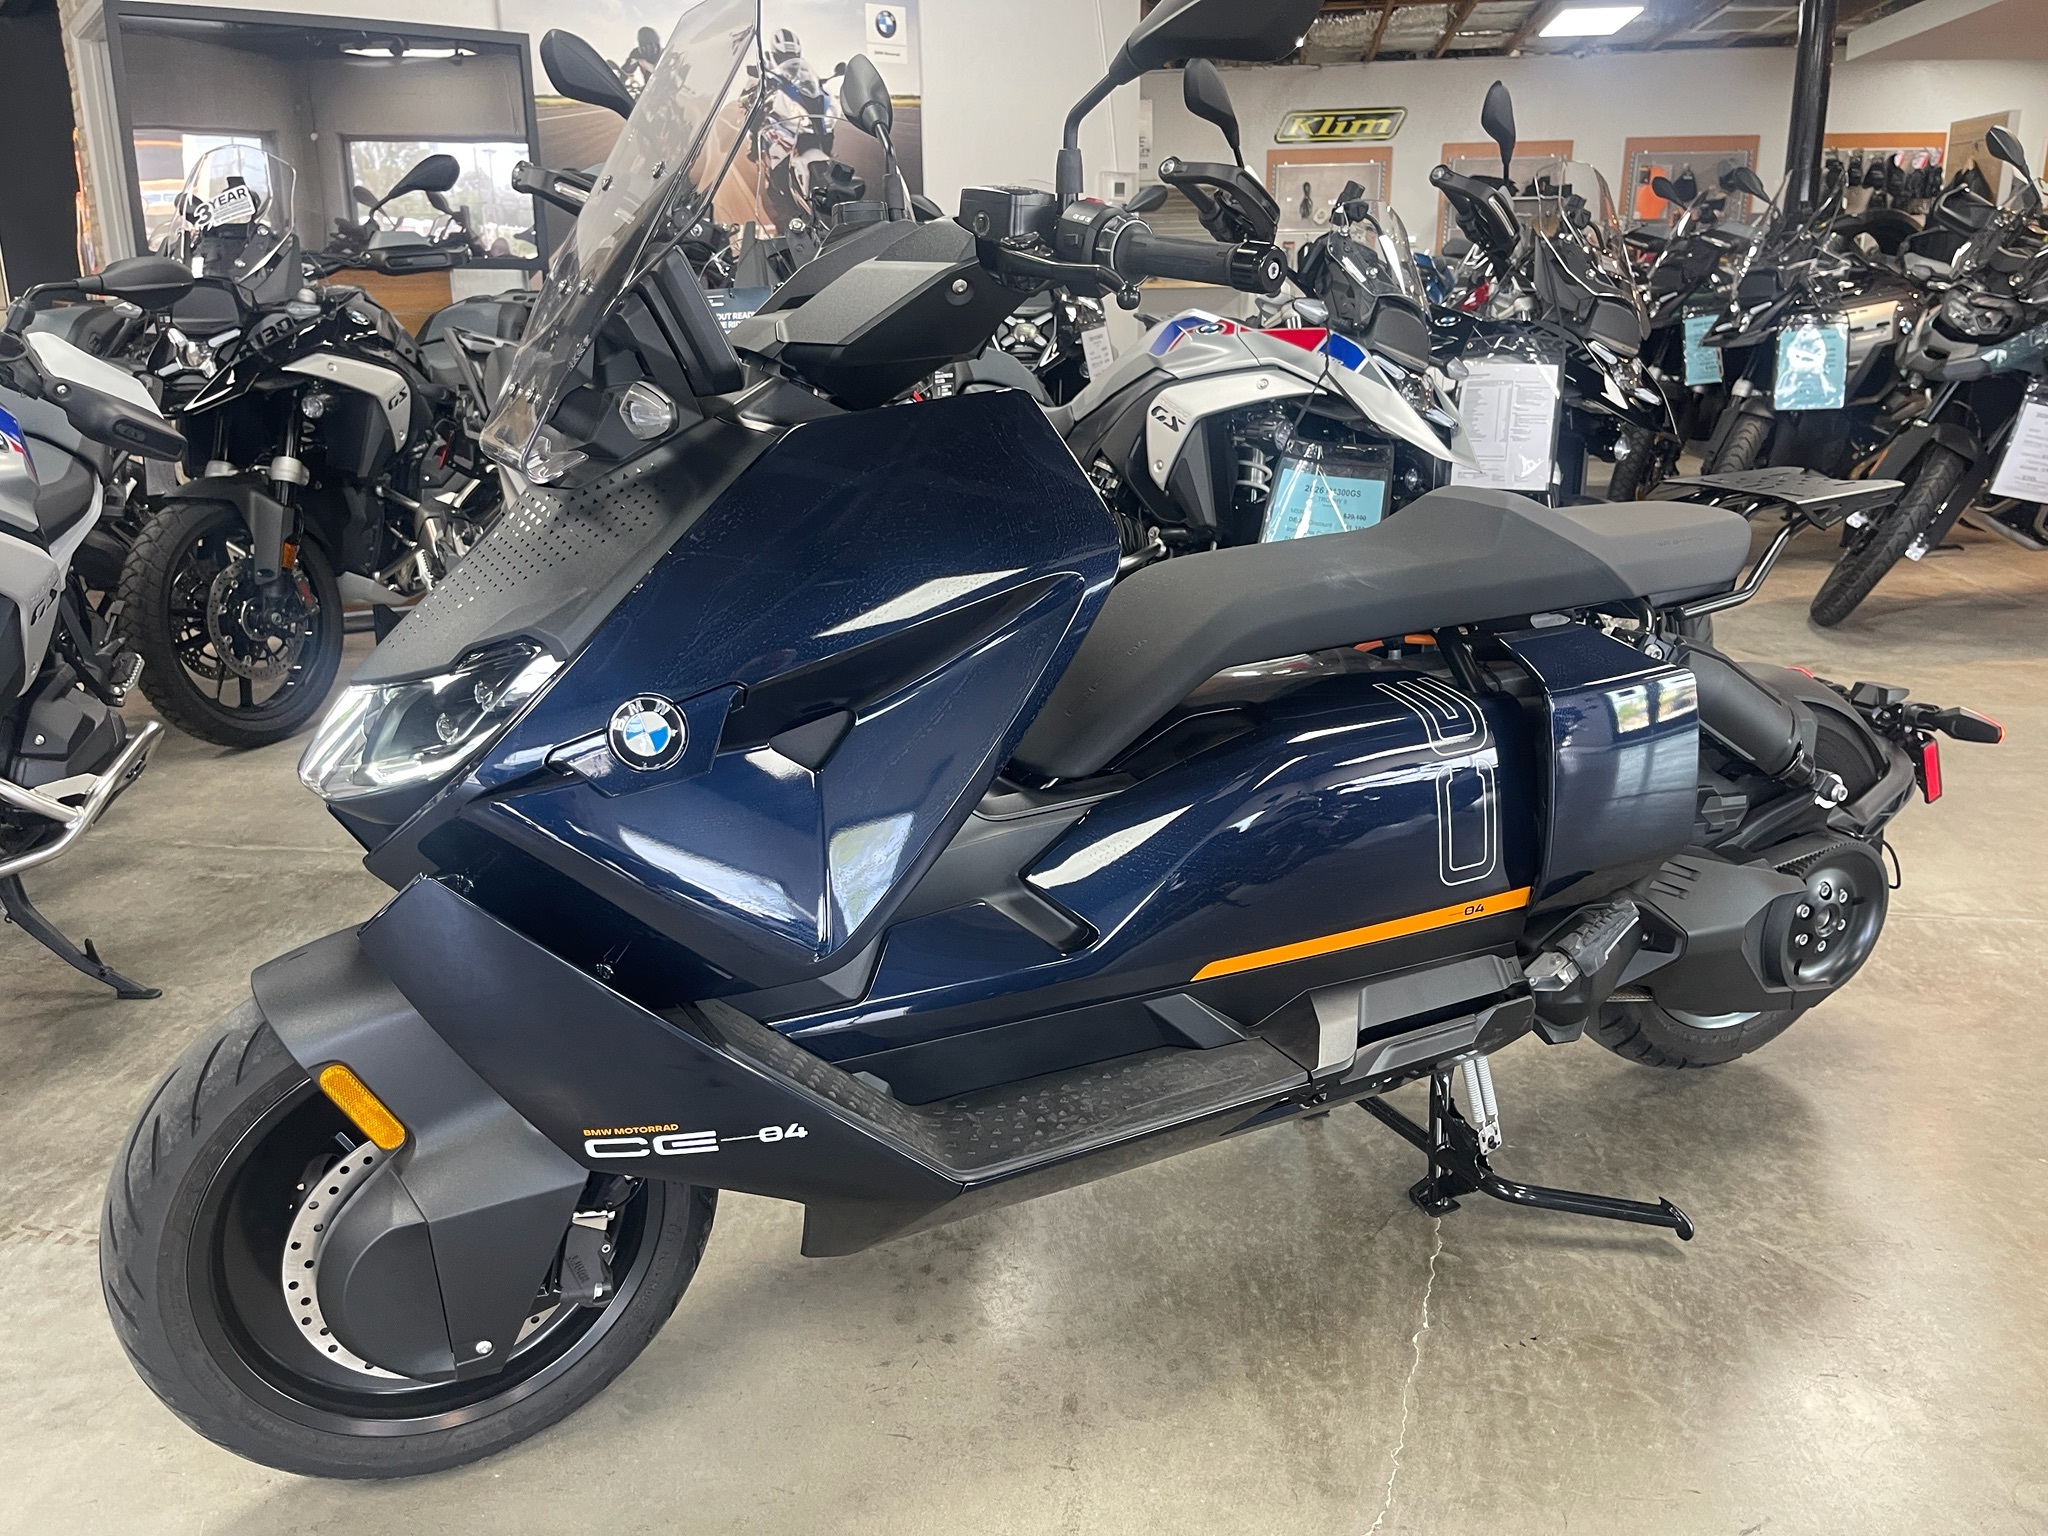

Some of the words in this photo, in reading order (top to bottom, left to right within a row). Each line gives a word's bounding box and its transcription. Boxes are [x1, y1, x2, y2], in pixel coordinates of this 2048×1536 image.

[1287, 116, 1392, 136] Klim
[197, 204, 212, 226] 3
[210, 187, 247, 209] YEAR
[388, 386, 408, 411] GS
[1151, 405, 1187, 432] GS
[1304, 484, 1325, 495] 226
[1326, 486, 1362, 498] 1300GS
[610, 699, 671, 731] BMW
[1464, 903, 1485, 916] 04
[583, 1127, 612, 1137] BMW
[614, 1123, 679, 1136] MOTORRAD
[584, 1130, 720, 1159] CE
